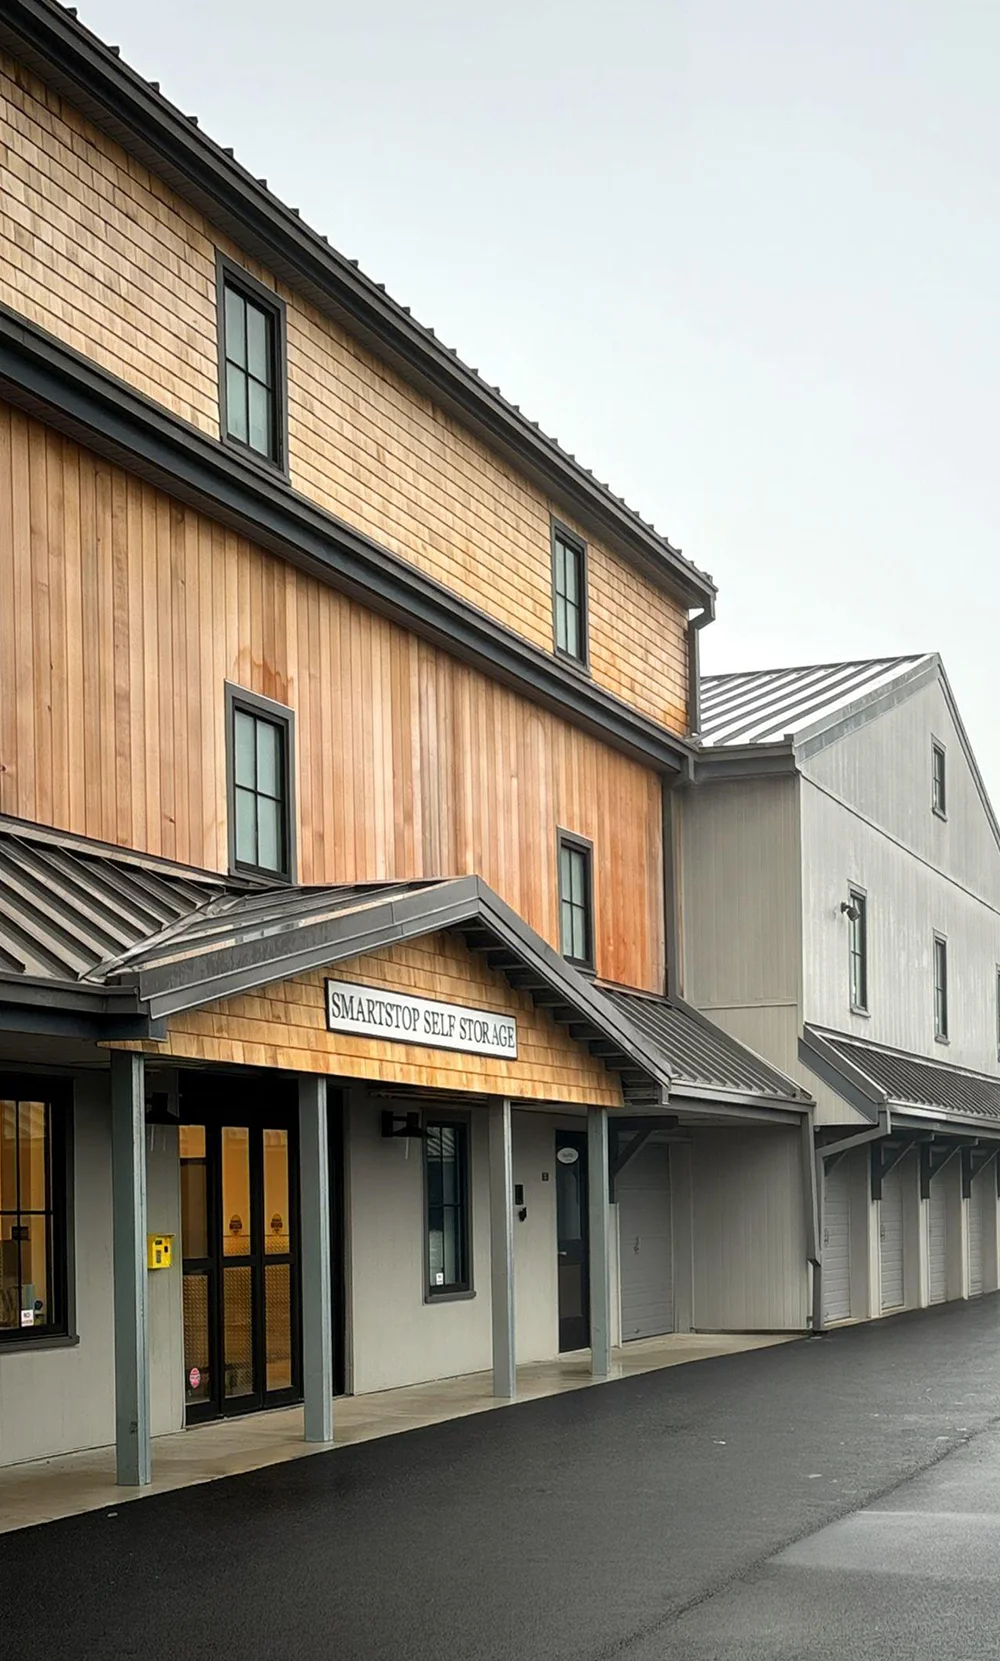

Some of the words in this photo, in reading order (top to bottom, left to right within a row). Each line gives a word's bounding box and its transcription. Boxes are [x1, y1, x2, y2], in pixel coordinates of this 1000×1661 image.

[331, 991, 420, 1032] SMARTSTOP
[423, 1009, 456, 1038] SELF
[459, 1016, 515, 1048] STORAGE
